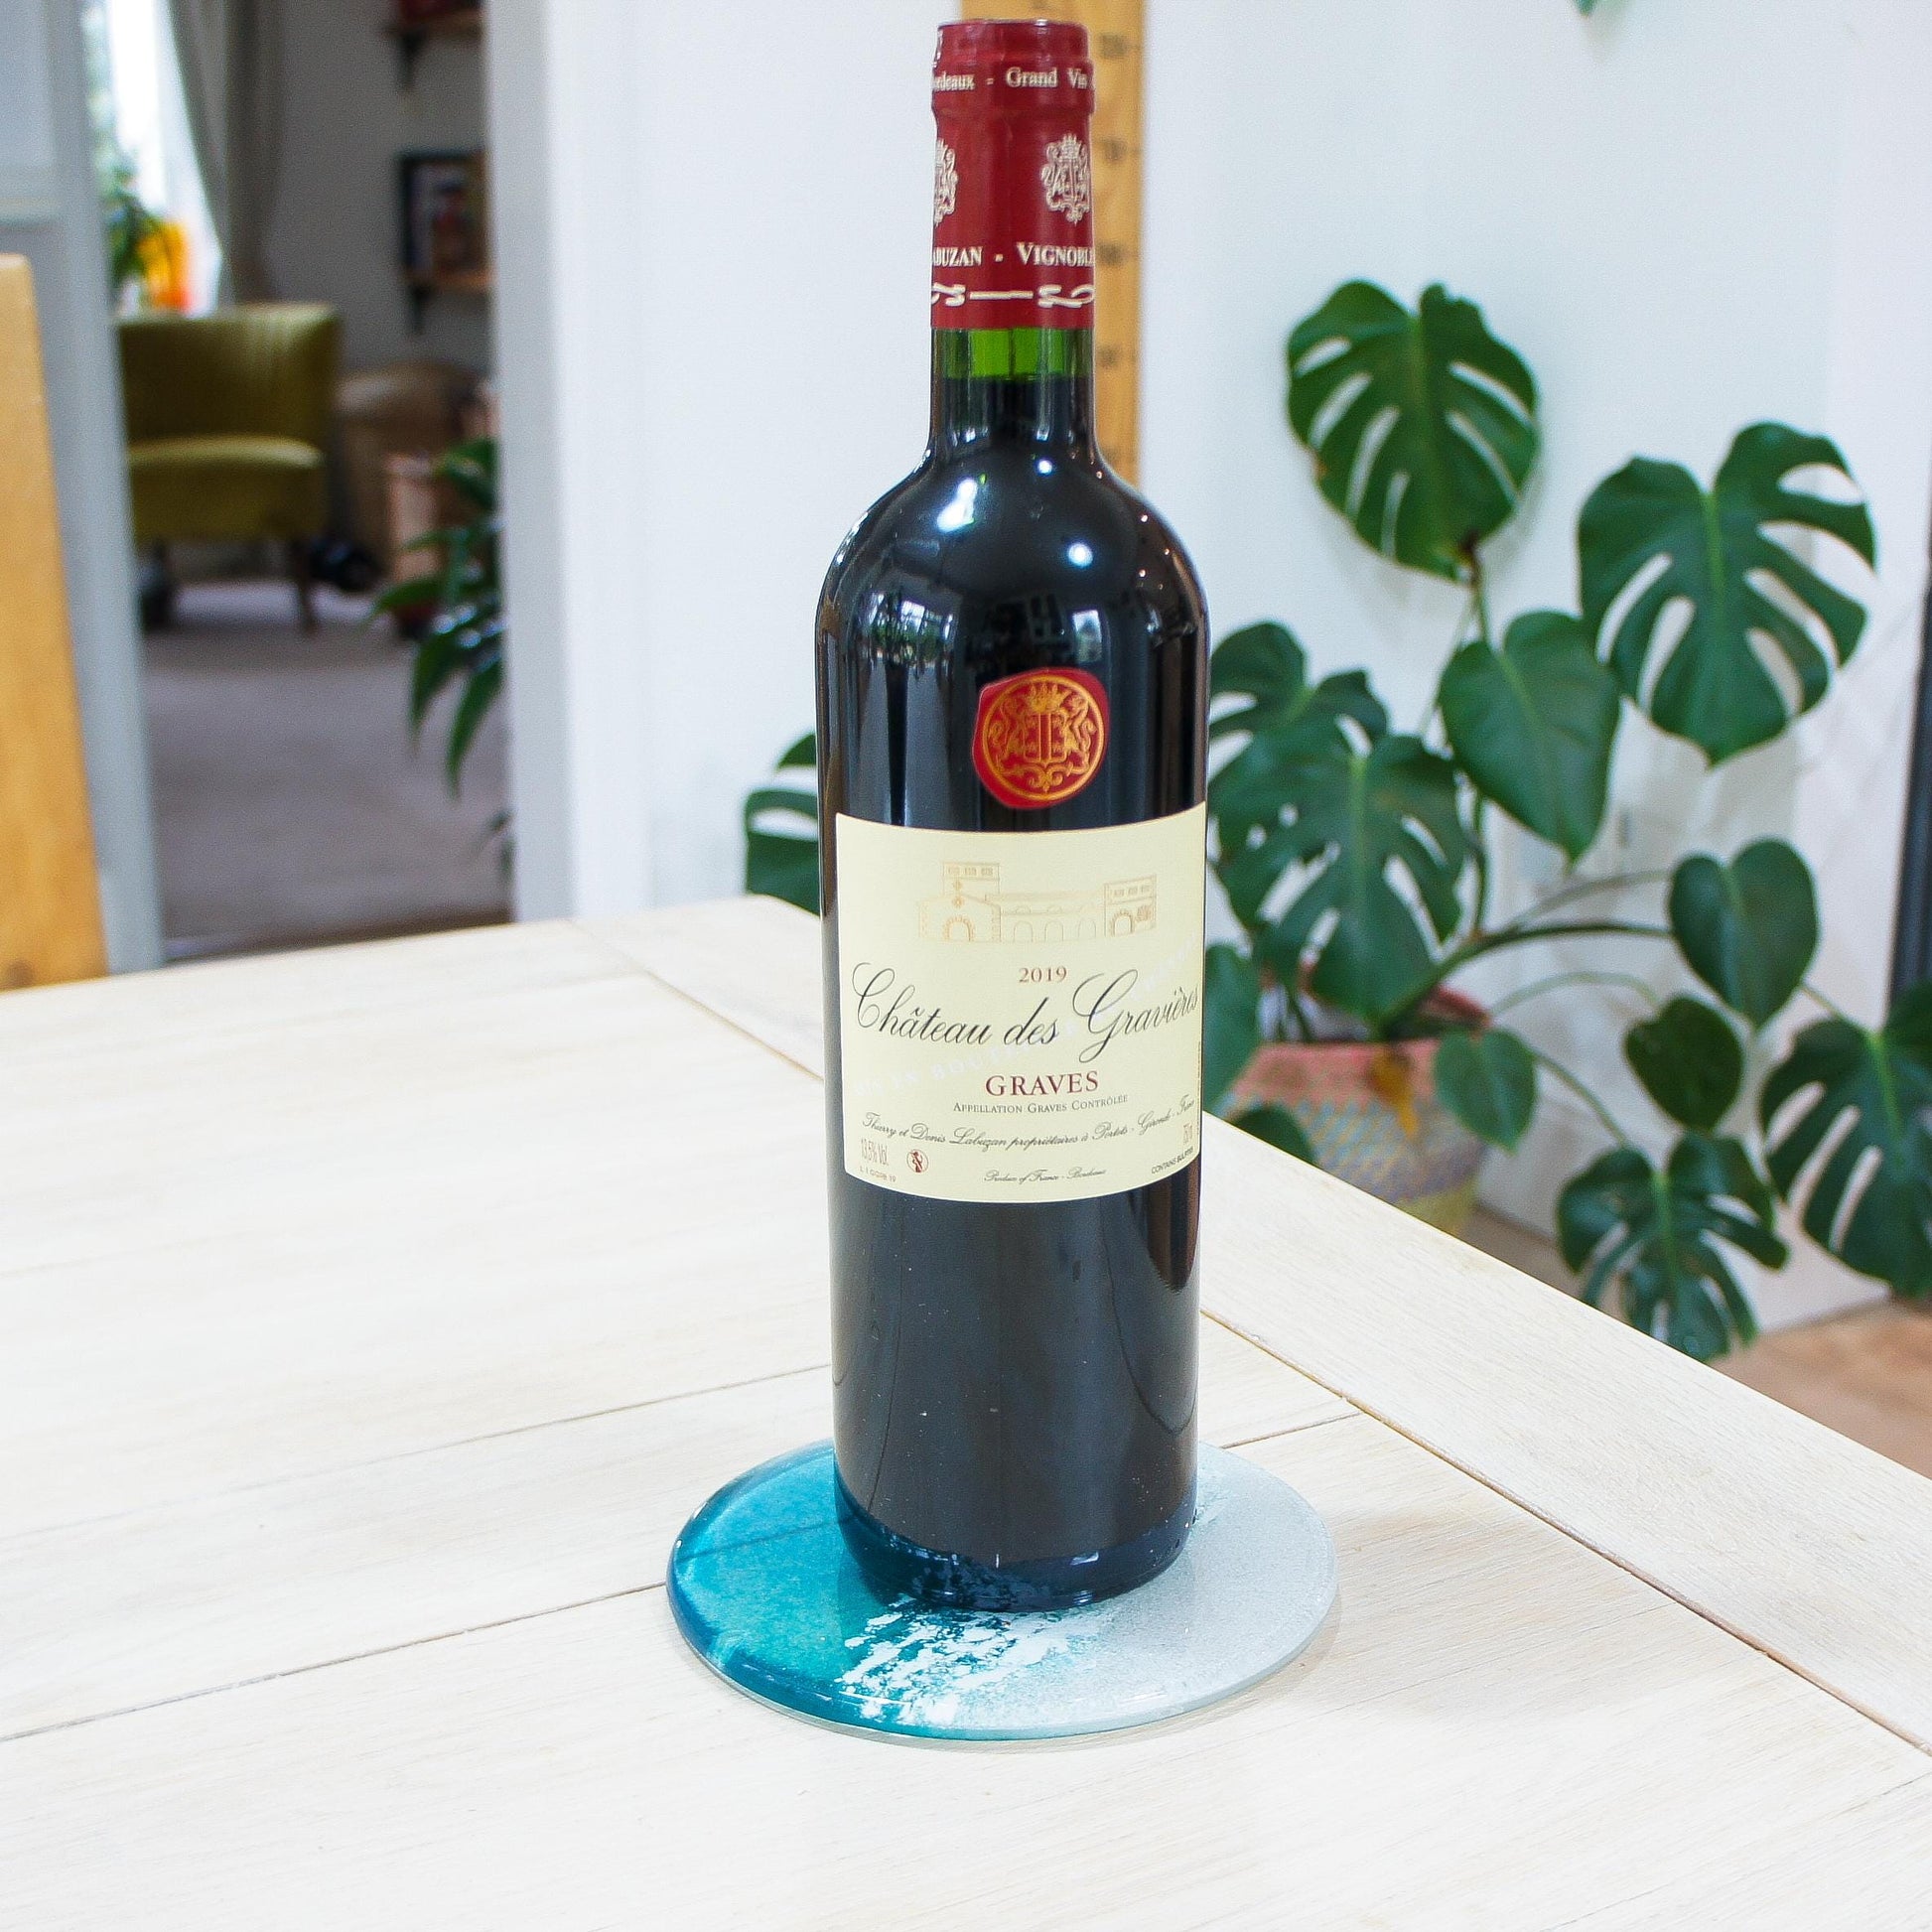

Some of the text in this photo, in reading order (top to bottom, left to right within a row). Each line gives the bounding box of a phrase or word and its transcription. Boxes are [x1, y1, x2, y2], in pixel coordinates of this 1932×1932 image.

[1006, 67, 1058, 88] Grand
[1019, 966, 1068, 984] 2019
[852, 962, 993, 1045] Château
[1003, 997, 1060, 1045] des
[985, 1070, 1099, 1097] GRAVES
[898, 1129, 910, 1138] et
[910, 1123, 946, 1144] Denis
[949, 1127, 1008, 1153] Labuzan
